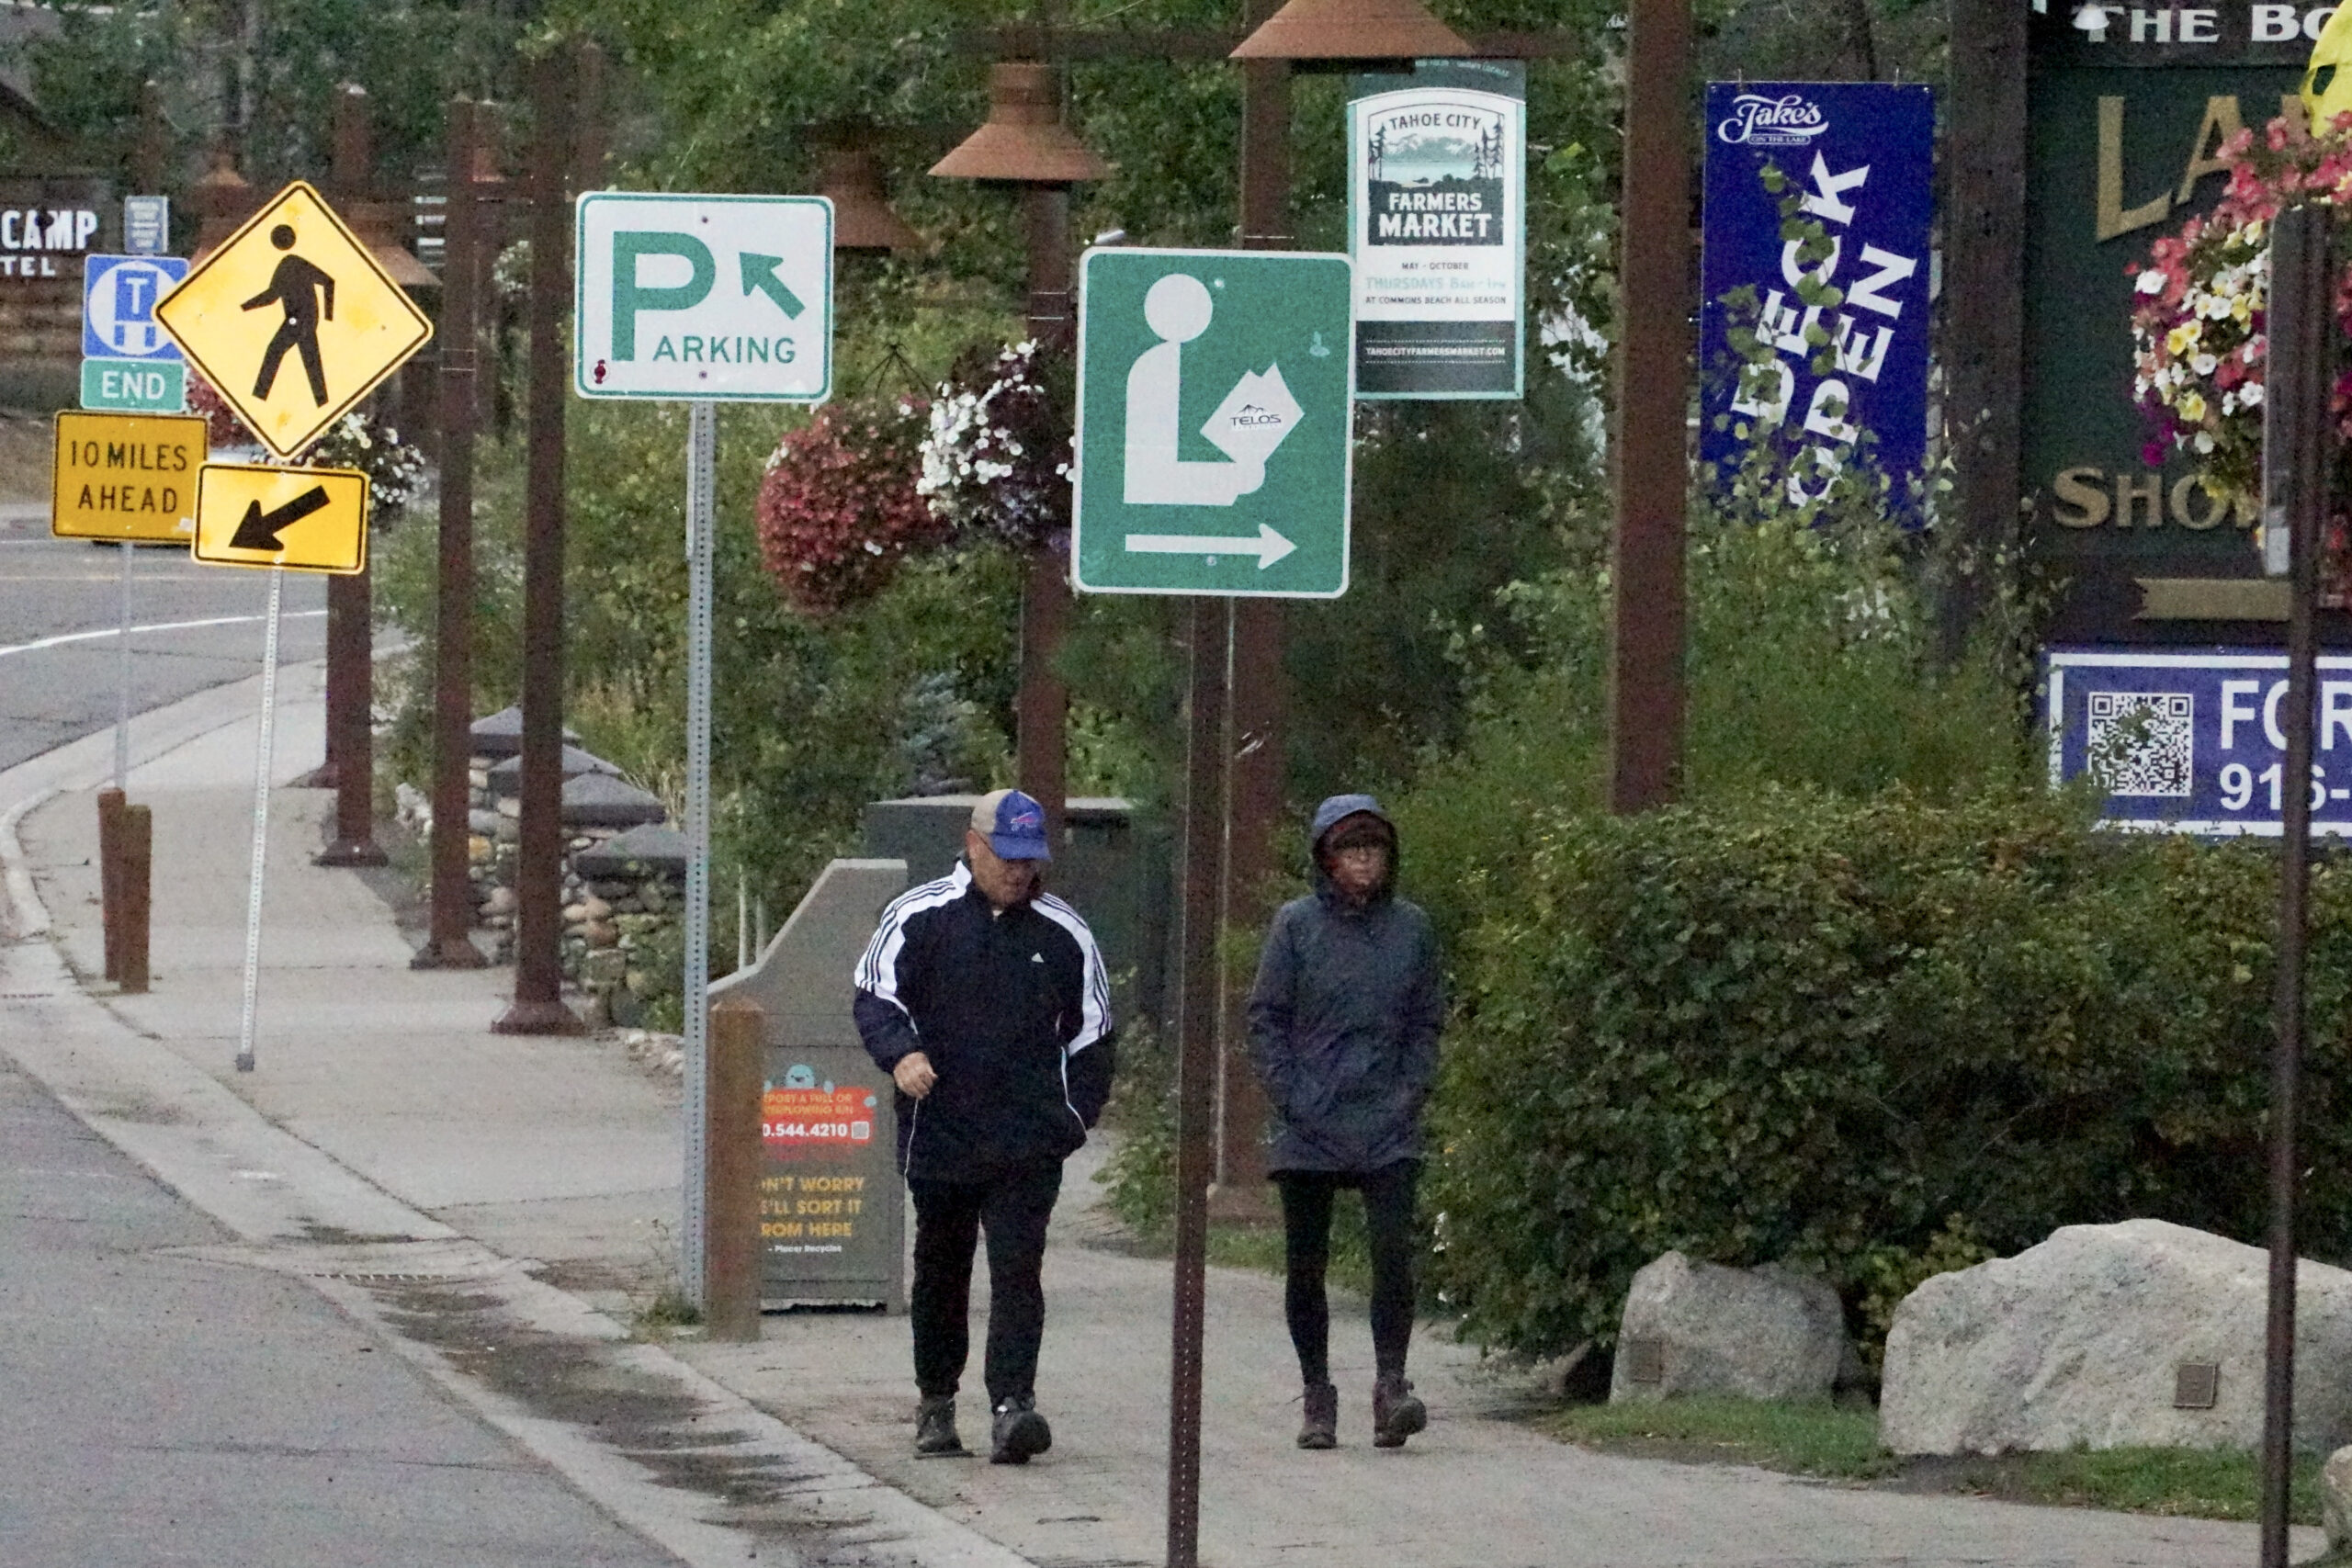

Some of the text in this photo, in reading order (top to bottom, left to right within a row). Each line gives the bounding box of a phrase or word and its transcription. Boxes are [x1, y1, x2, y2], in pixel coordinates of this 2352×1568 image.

[1389, 113, 1481, 130] TAHOE CITY
[1718, 94, 1829, 143] Jake's
[1389, 192, 1483, 211] FARMERS
[1, 209, 97, 250] CAMP
[1379, 213, 1493, 237] MARKET
[1401, 262, 1419, 270] MAY
[1430, 262, 1469, 270] OCTOBER
[1365, 276, 1442, 289] THURSDAYS
[1365, 296, 1507, 305] AT COMMONS BEACH ALL SEASON
[102, 370, 165, 400] END
[1230, 413, 1282, 426] TELOS
[72, 440, 187, 471] 10 MILES
[78, 483, 177, 513] AHEAD
[798, 1177, 865, 1191] WORRY
[797, 1200, 842, 1214] SORT
[847, 1200, 863, 1213] IT
[808, 1223, 852, 1237] HERE
